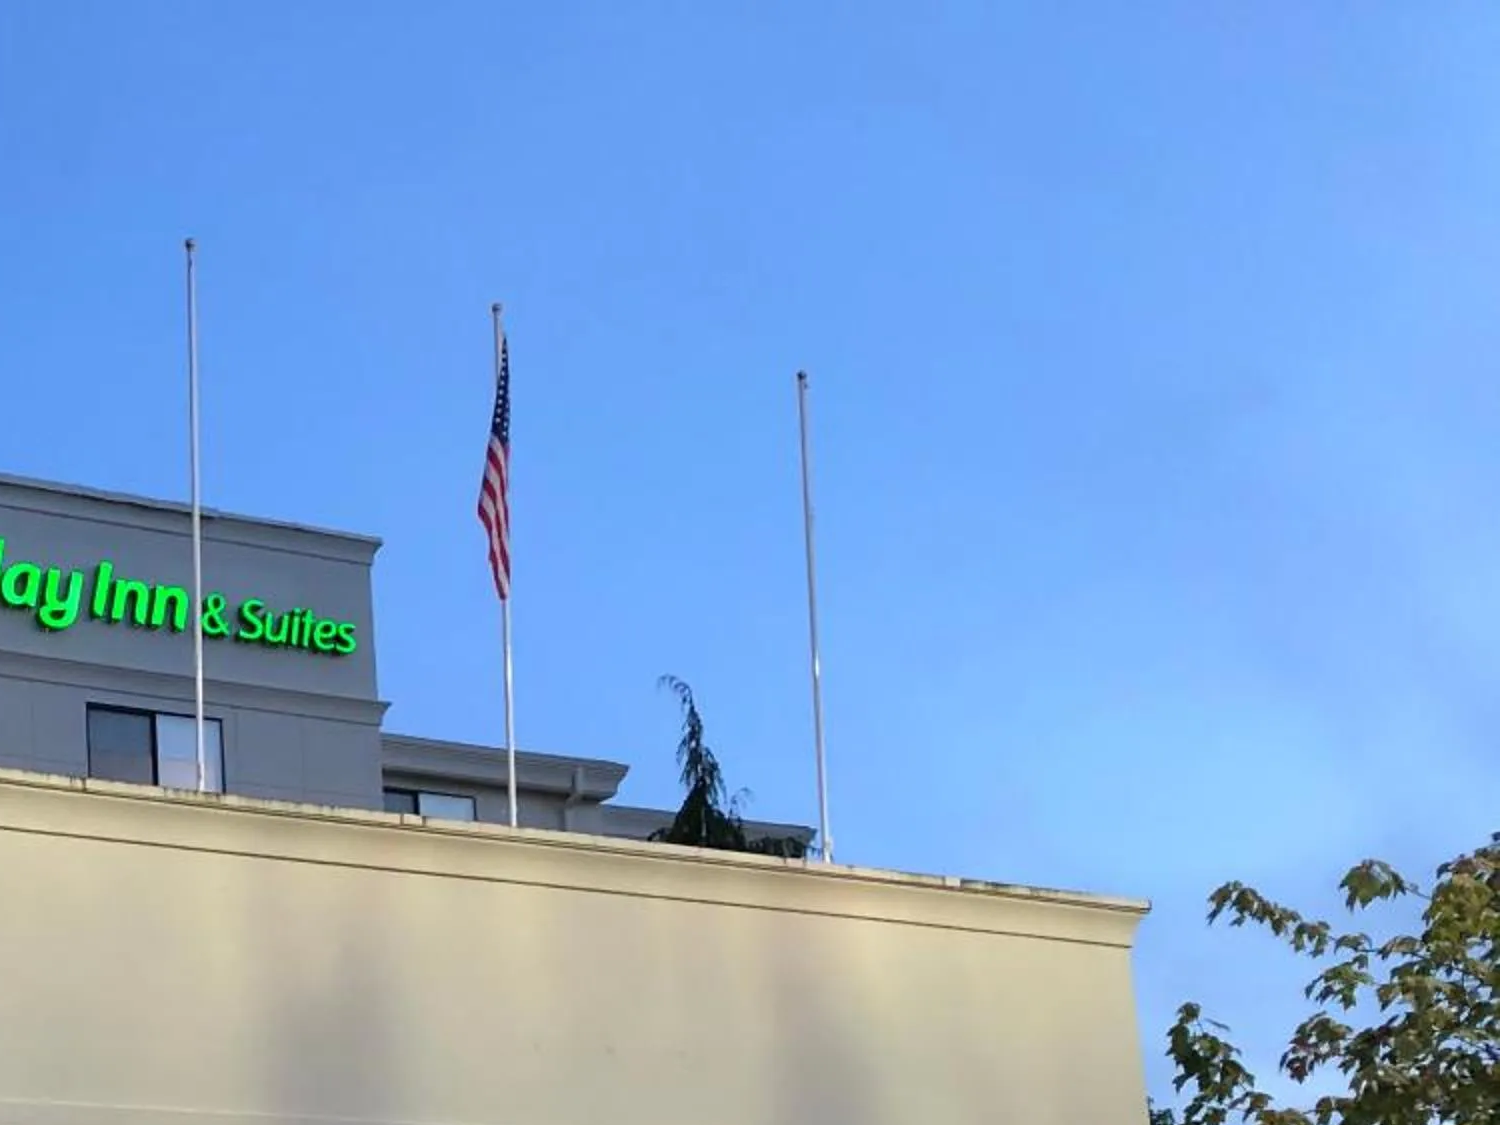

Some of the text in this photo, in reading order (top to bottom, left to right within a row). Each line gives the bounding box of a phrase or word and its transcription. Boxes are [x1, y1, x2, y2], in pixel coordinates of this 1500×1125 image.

[92, 560, 189, 632] Inn
[199, 594, 230, 637] &
[239, 598, 358, 654] Suites
